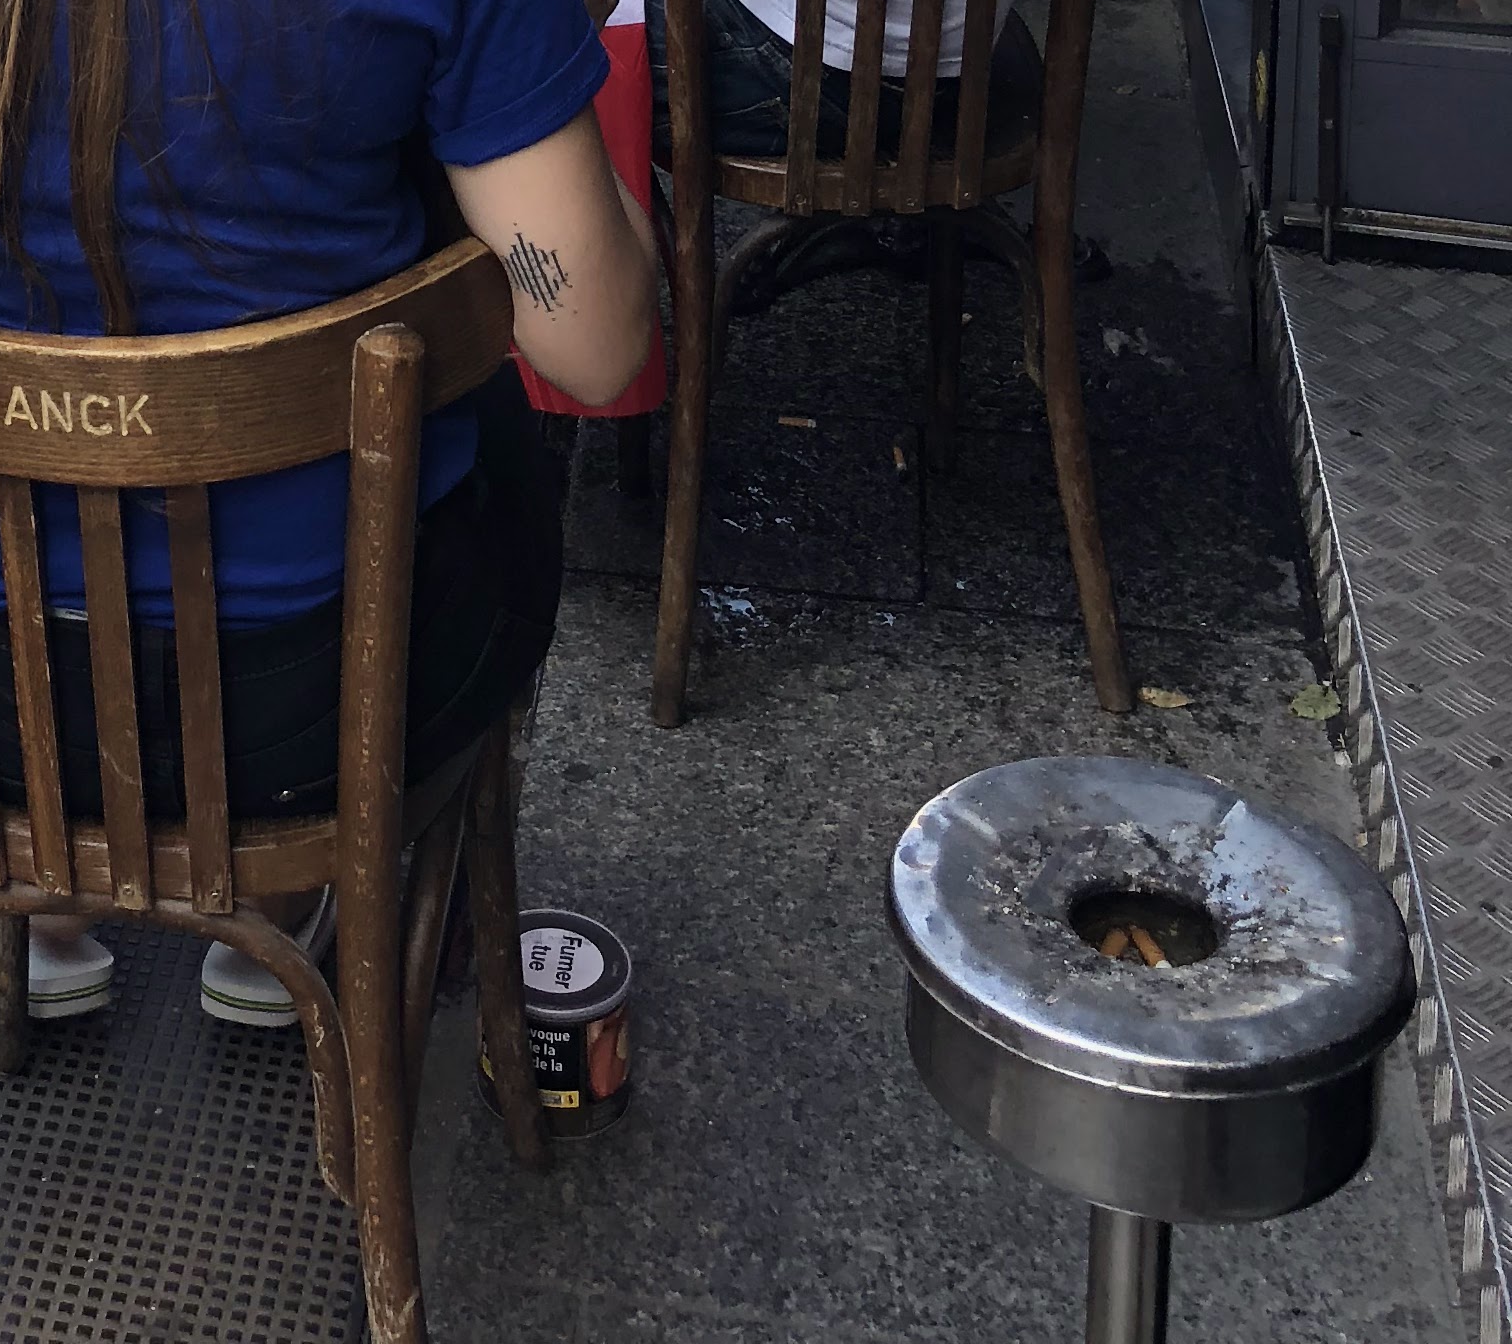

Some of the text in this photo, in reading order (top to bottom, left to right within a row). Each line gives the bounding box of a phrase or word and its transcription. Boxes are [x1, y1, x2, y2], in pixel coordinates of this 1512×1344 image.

[529, 945, 551, 972] tue
[555, 935, 583, 989] Fumer
[544, 1043, 555, 1056] la
[551, 1058, 563, 1072] la
